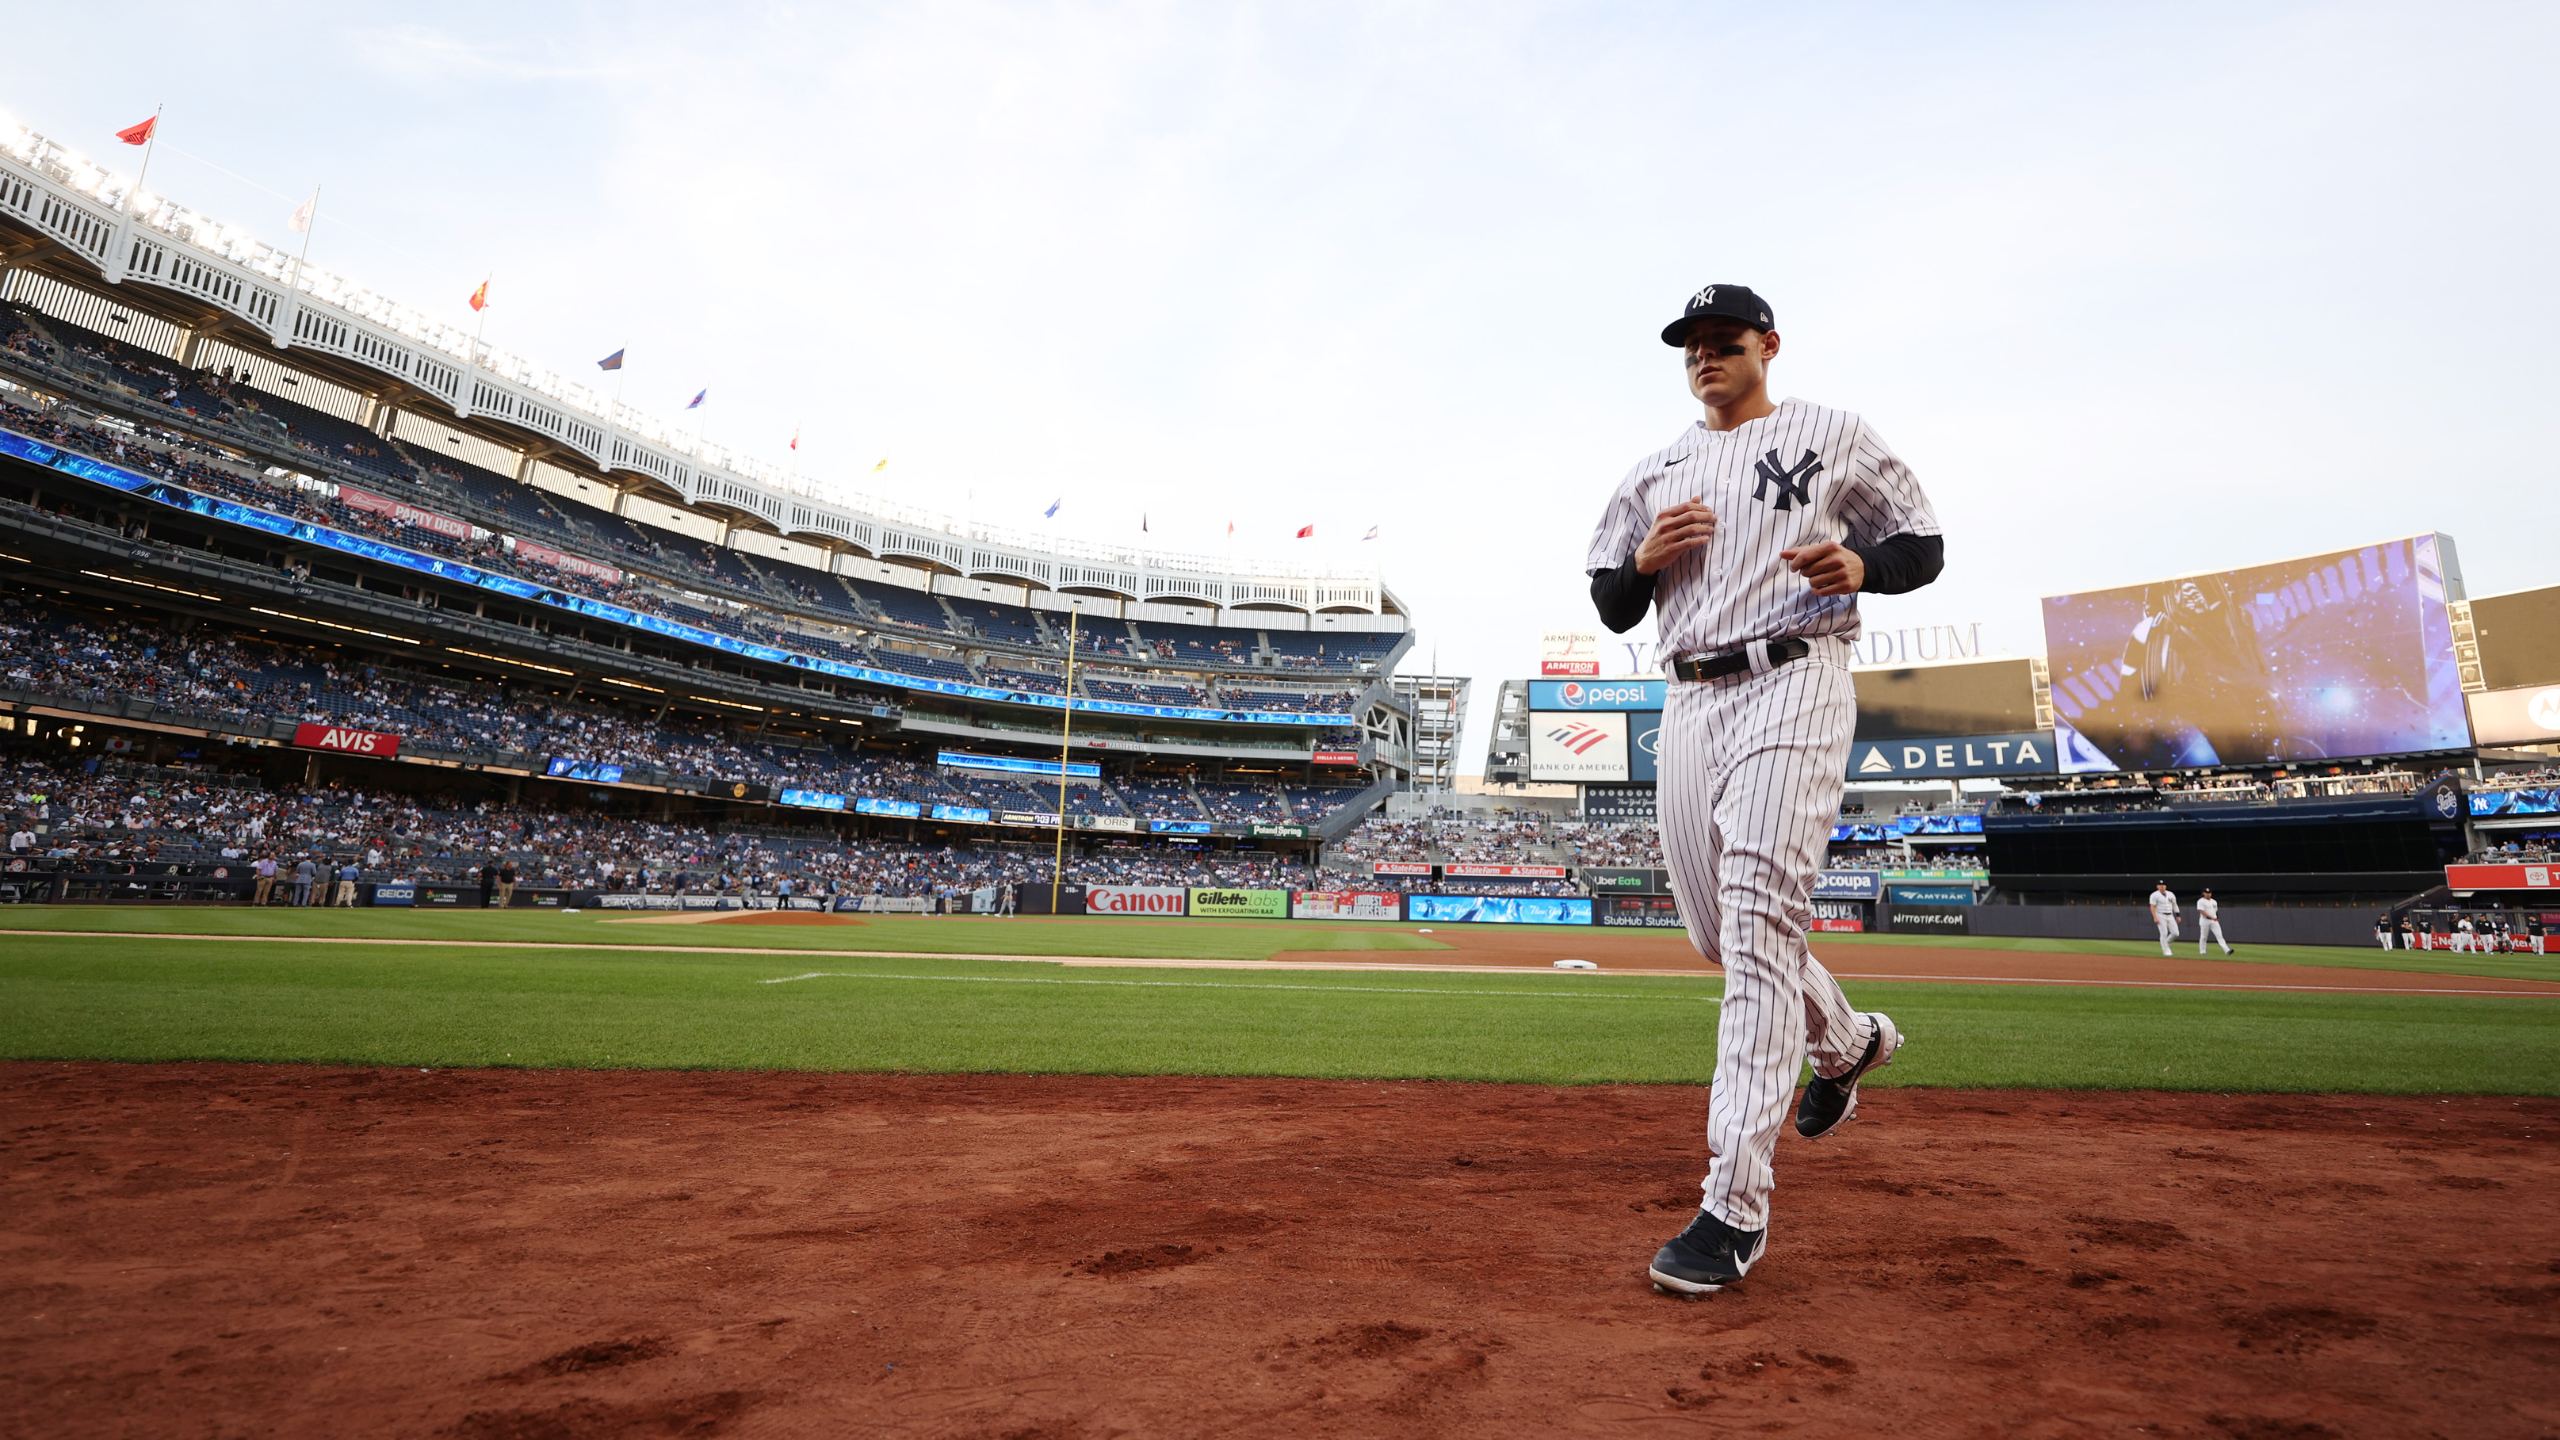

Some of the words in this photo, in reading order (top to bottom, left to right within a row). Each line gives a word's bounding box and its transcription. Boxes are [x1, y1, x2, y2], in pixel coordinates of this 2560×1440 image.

[1692, 286, 1716, 309] NY
[1752, 447, 1825, 511] NY
[394, 504, 434, 527] PARTY
[433, 517, 466, 536] DECK
[559, 555, 588, 574] PARTY
[588, 564, 614, 582] DECK
[1545, 662, 1595, 670] ARMITRON
[1589, 685, 1645, 706] pepsi
[319, 729, 377, 752] AVIS
[1903, 740, 2042, 770] DELTA
[1532, 763, 1560, 771] BANK
[1563, 763, 1576, 771] OF
[1578, 763, 1625, 771] AMERICA
[1003, 813, 1034, 822] ARMITRON
[1103, 818, 1129, 828] ORIS
[1253, 824, 1278, 836] Poland
[1278, 825, 1303, 838] Spring
[1595, 876, 1617, 886] Uber
[1618, 876, 1642, 886] Eats
[1828, 875, 1872, 891] coupa
[376, 889, 414, 899] GEICO
[1086, 888, 1182, 913] Canon
[841, 899, 859, 908] ACC
[1603, 915, 1642, 926] StubHub
[1645, 917, 1686, 927] StubHub
[1893, 912, 1963, 926] NITTOTIRE.COM
